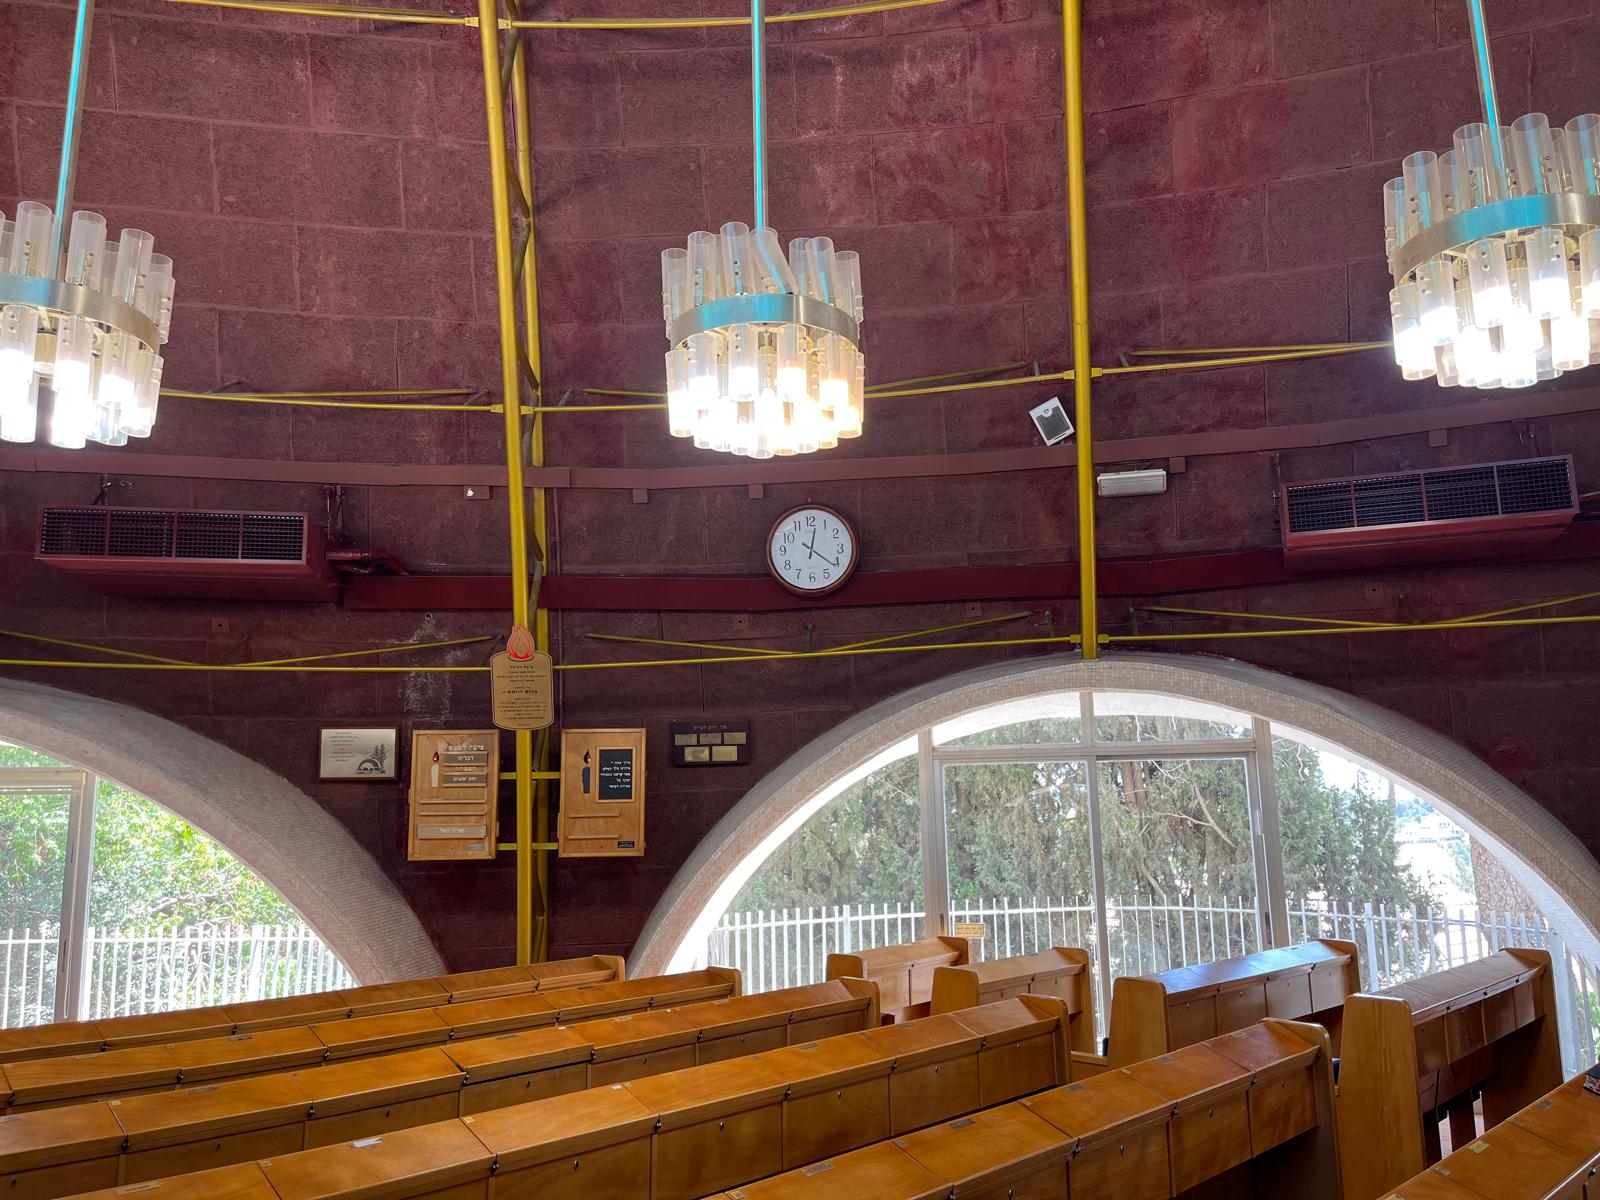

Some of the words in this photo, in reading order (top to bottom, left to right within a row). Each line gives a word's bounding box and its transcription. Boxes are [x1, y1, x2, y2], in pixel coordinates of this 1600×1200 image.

[793, 520, 801, 532] 11
[806, 516, 816, 528] 12
[823, 519, 827, 530] 1
[783, 532, 795, 544] 10
[832, 528, 840, 539] 2
[779, 544, 787, 556] 9
[836, 543, 844, 554] 3
[784, 559, 792, 571] 8
[833, 556, 840, 568] 4
[795, 568, 802, 580] 7
[808, 572, 816, 583] 6
[823, 568, 830, 580] 5
